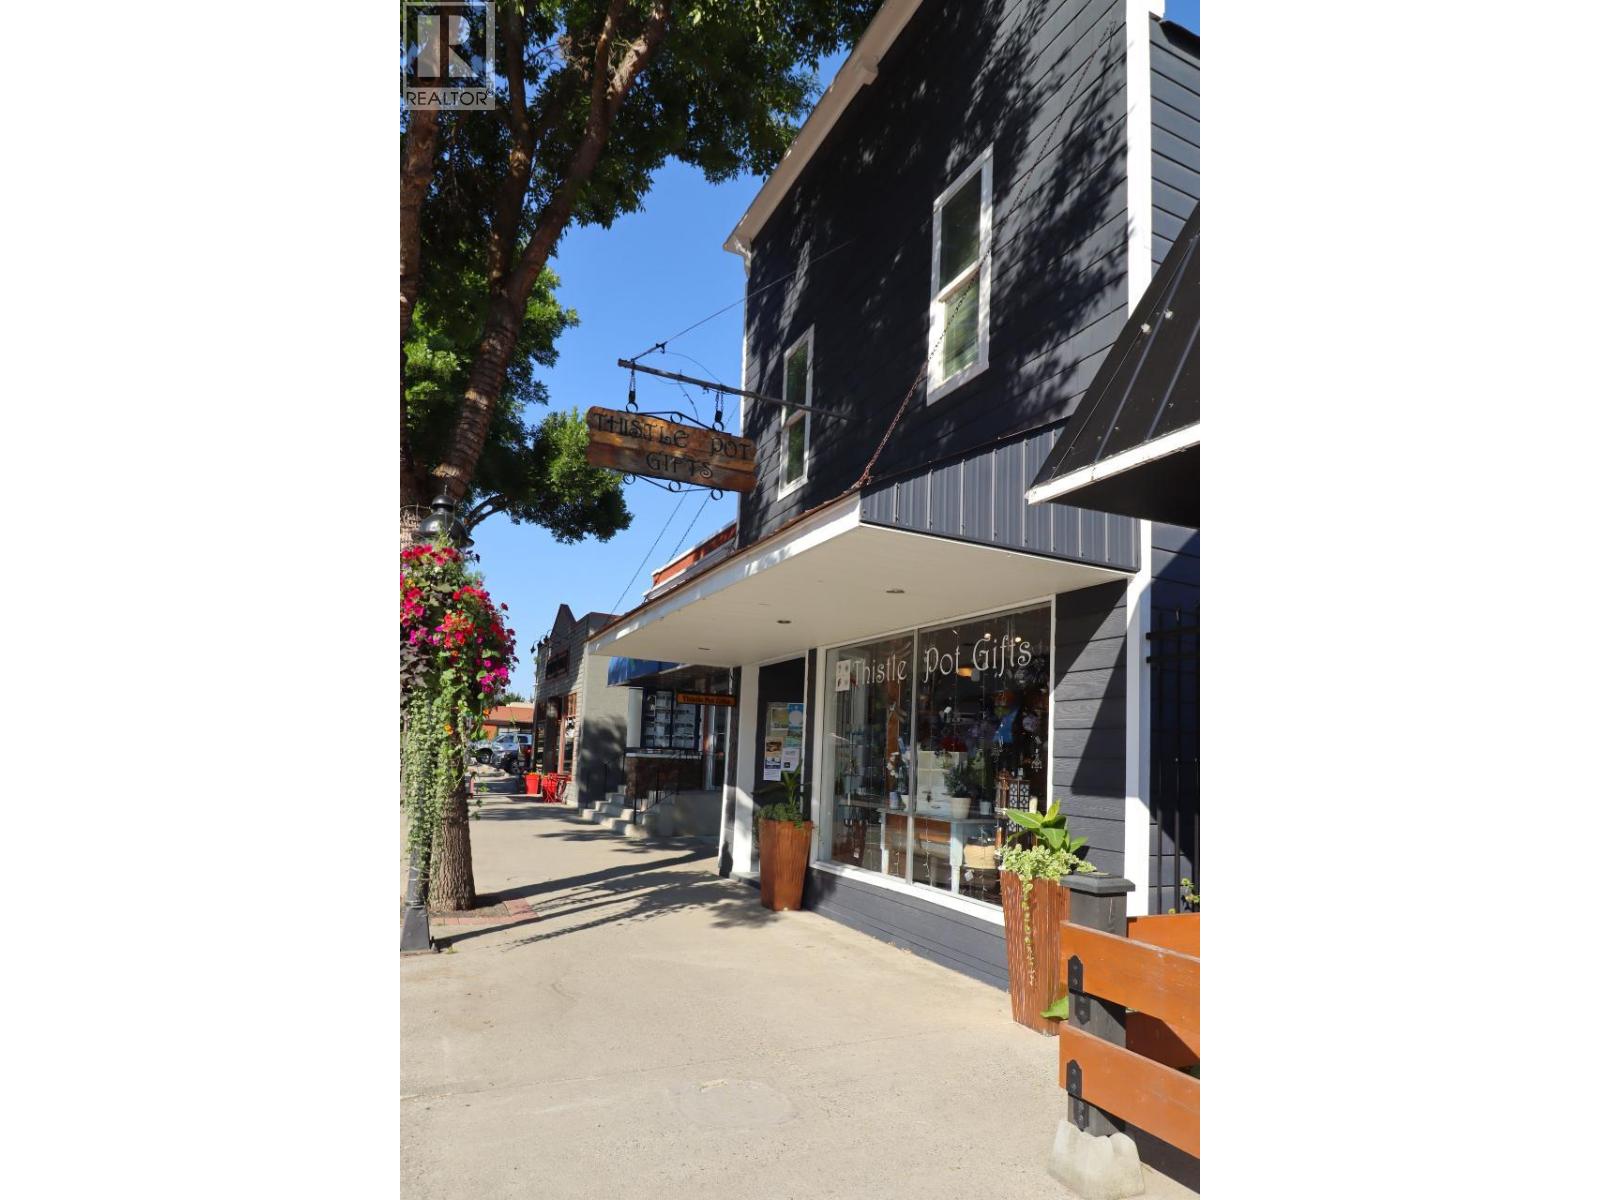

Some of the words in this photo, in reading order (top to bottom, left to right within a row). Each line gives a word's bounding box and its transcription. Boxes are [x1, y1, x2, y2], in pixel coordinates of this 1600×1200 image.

[593, 413, 689, 448] THISTLE
[710, 434, 751, 460] POT
[646, 452, 713, 478] GIFTS
[853, 654, 907, 684] Thistle
[923, 645, 961, 683] Pot
[972, 634, 1032, 678] Gifts
